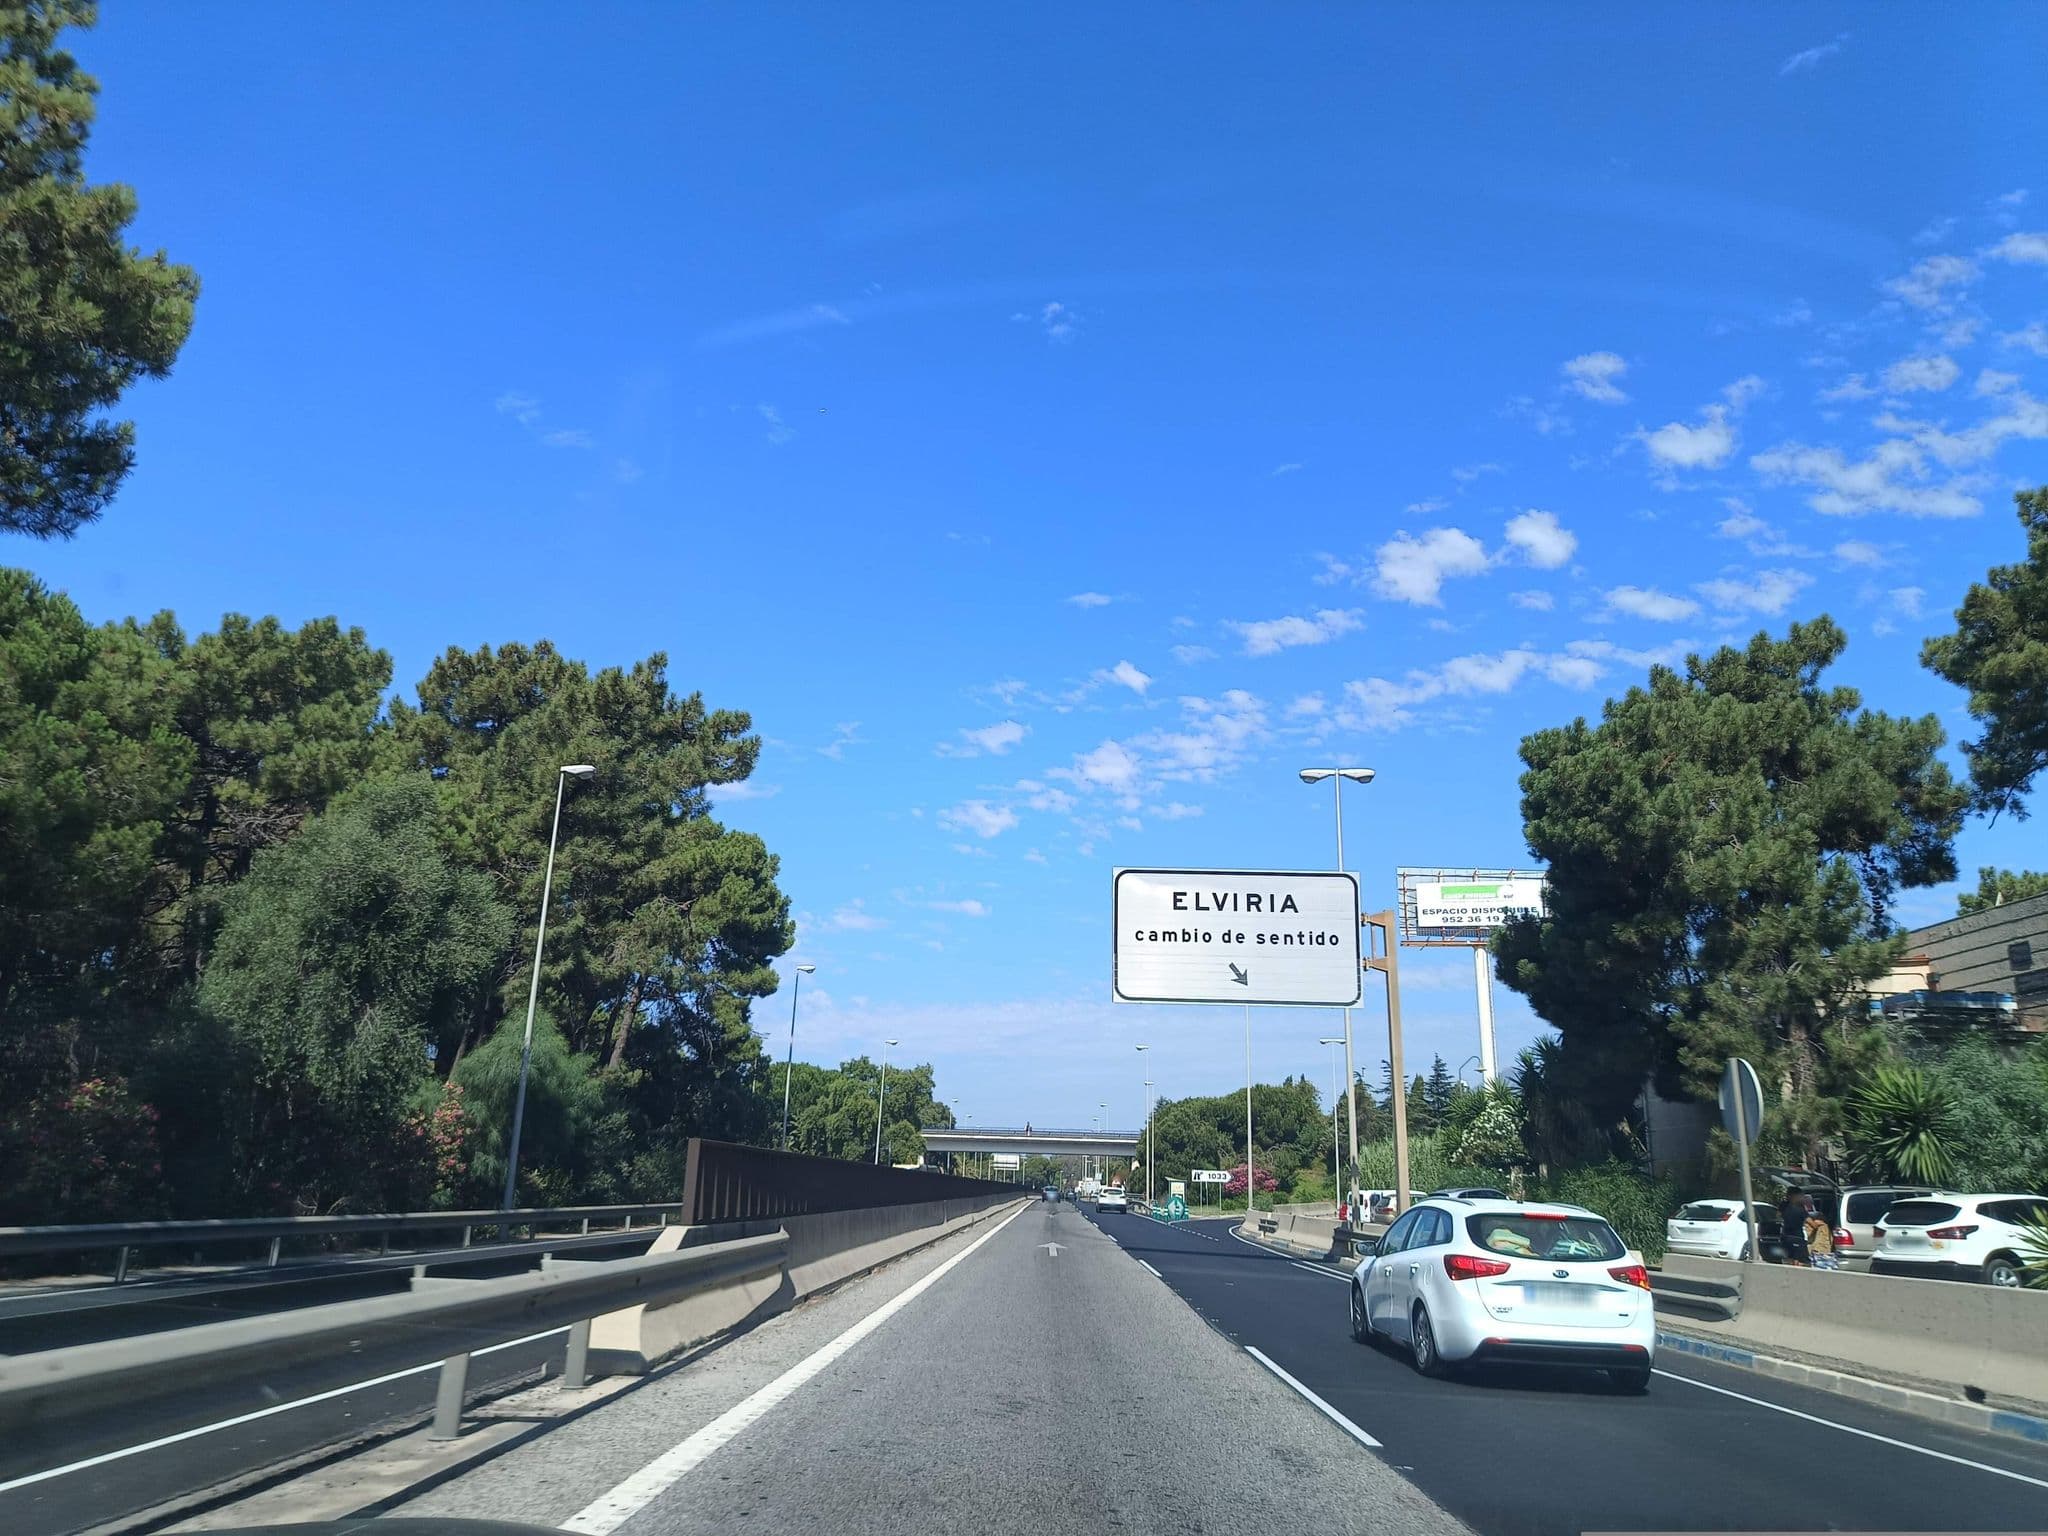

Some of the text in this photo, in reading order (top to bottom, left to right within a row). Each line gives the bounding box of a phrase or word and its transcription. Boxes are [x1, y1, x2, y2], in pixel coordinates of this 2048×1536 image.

[1172, 891, 1299, 914] ELVIRIA
[1422, 906, 1538, 915] ESPACIO DISPOIBE
[1467, 915, 1482, 923] 36
[1135, 928, 1340, 946] cambio de sentido
